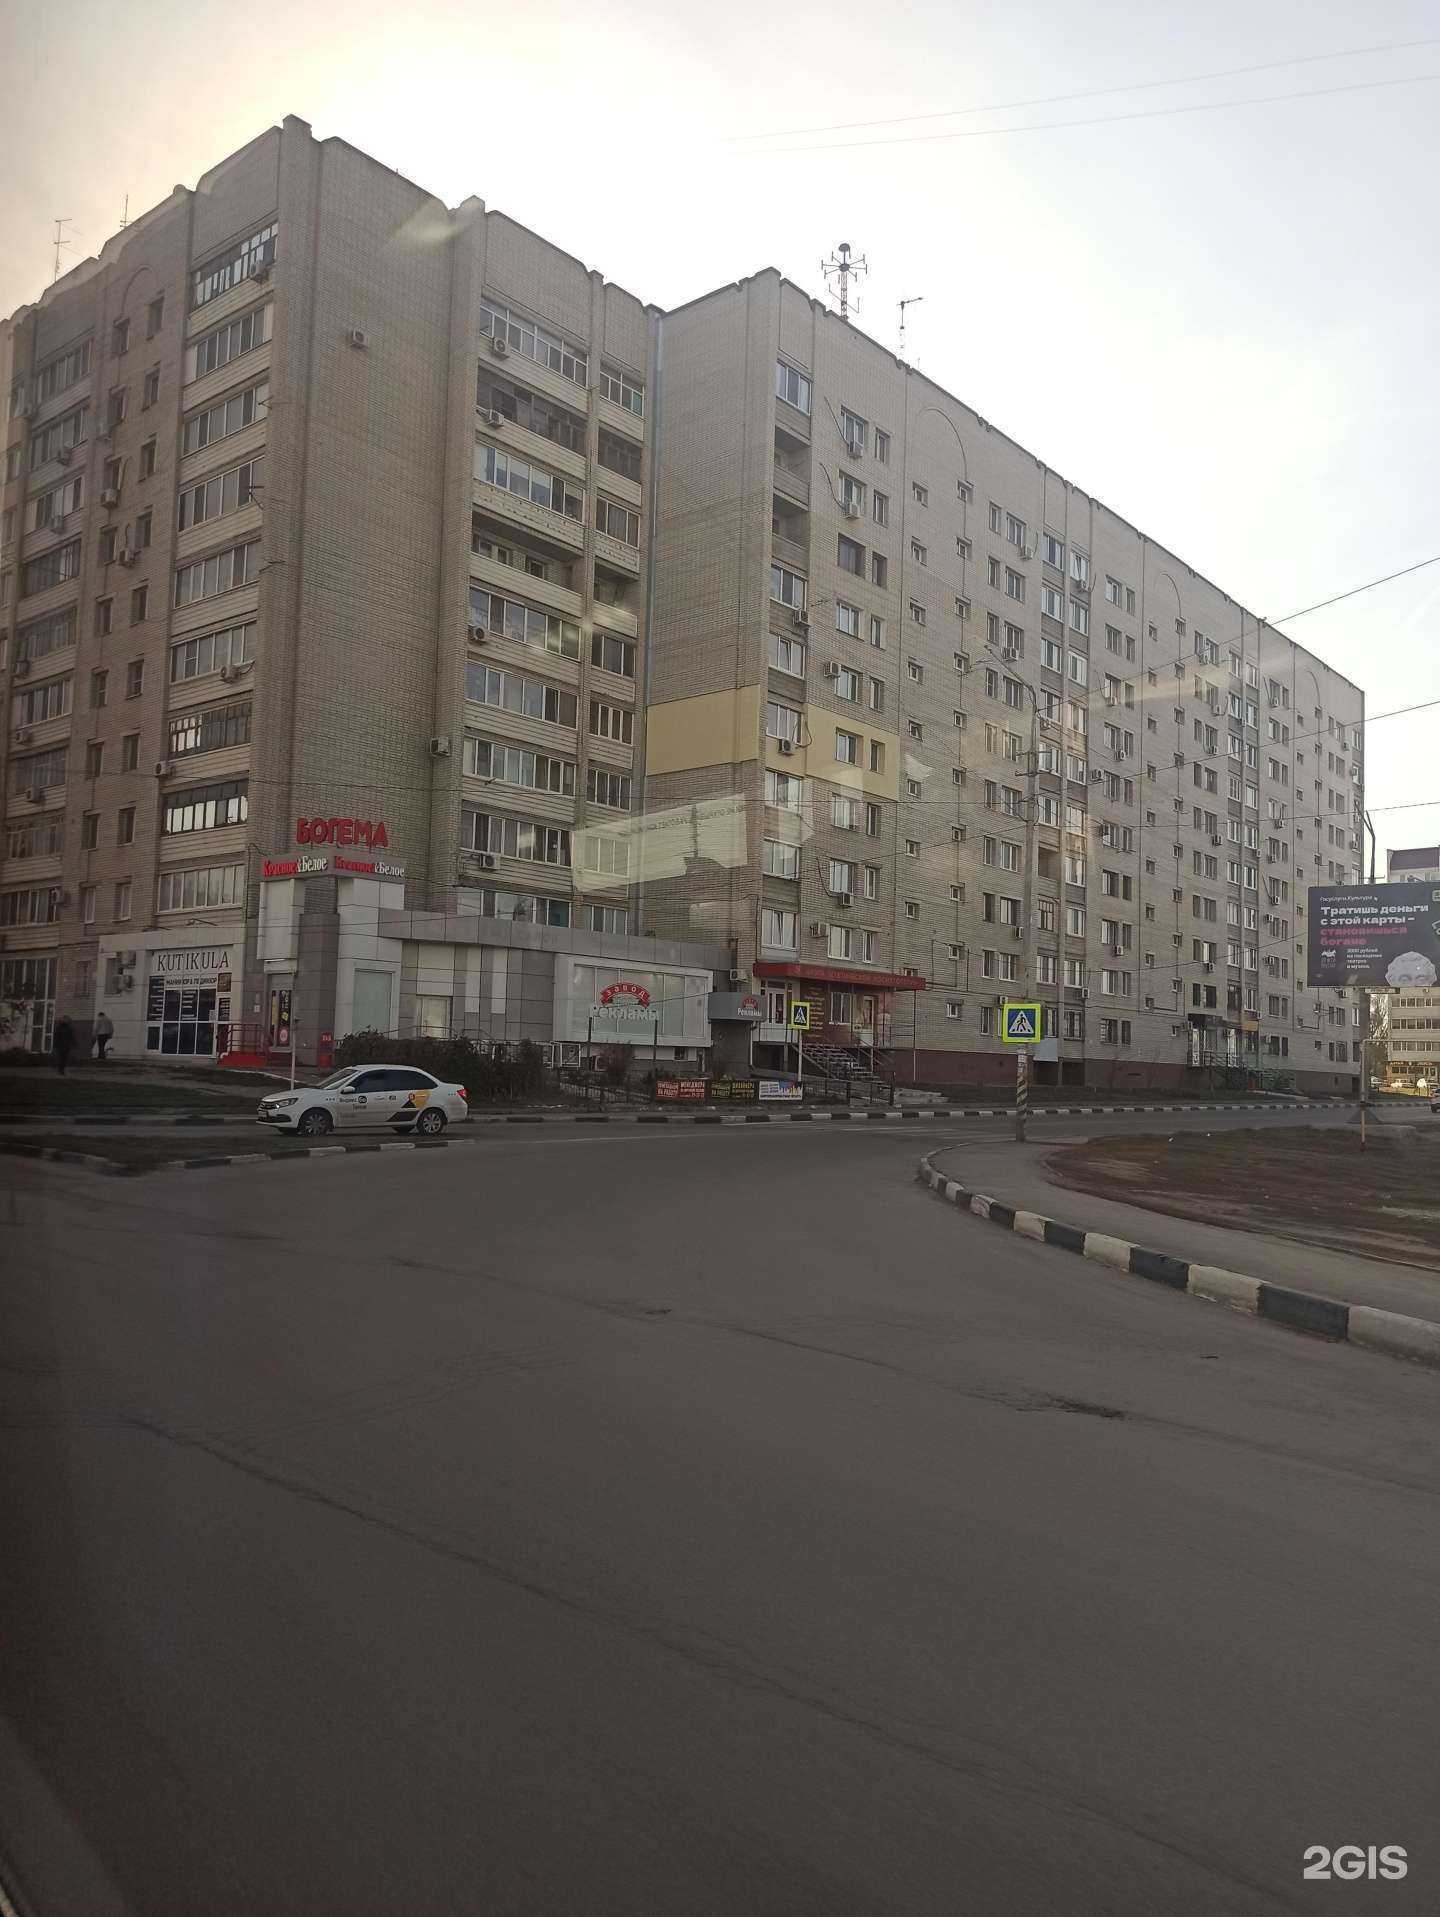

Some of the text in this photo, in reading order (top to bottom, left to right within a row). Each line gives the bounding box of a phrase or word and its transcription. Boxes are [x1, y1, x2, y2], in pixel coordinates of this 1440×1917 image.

[296, 817, 389, 848] БОГЕМА
[1320, 904, 1429, 918] Тратишь деньги
[1320, 918, 1328, 926] с
[1329, 916, 1361, 926] этой
[1362, 916, 1406, 927] карты
[157, 951, 229, 971] KUTIKULA
